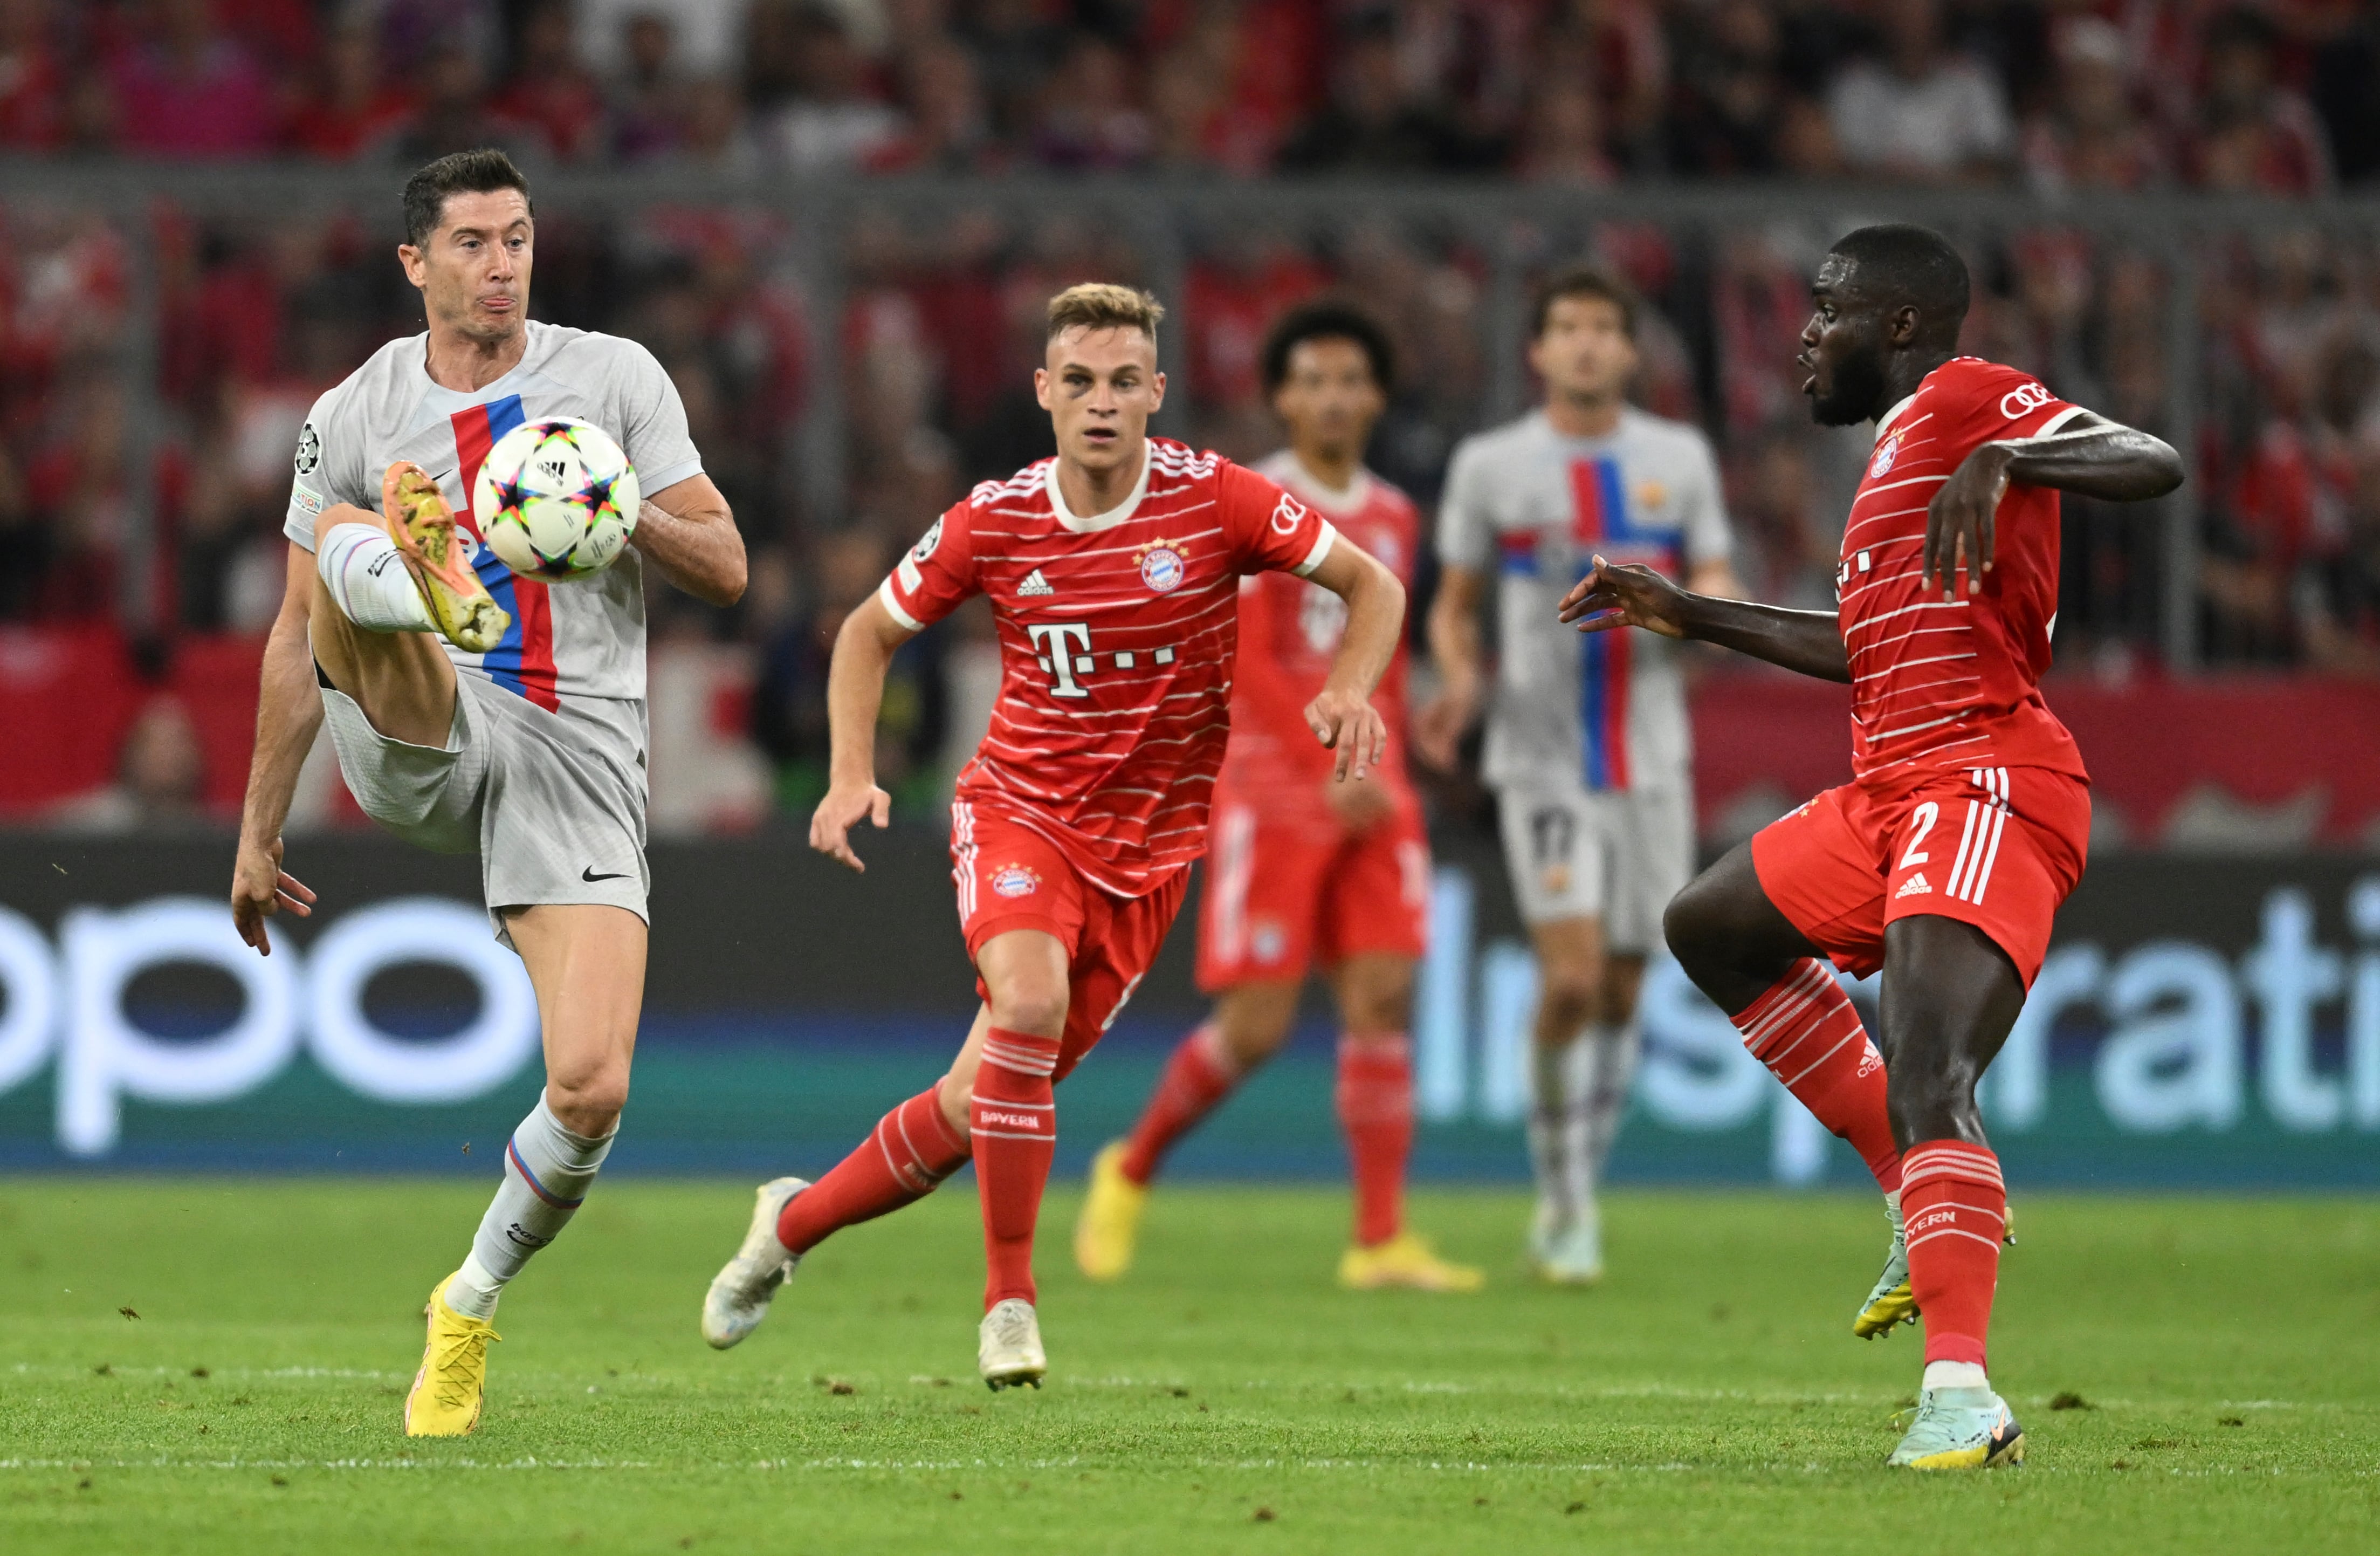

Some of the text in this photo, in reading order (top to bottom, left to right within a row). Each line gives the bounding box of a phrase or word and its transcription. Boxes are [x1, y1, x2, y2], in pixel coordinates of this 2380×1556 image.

[1017, 586, 1054, 597] adidas
[1899, 801, 1939, 870] 2
[1895, 885, 1932, 899] adidas
[981, 1111, 1040, 1128] BAYERN
